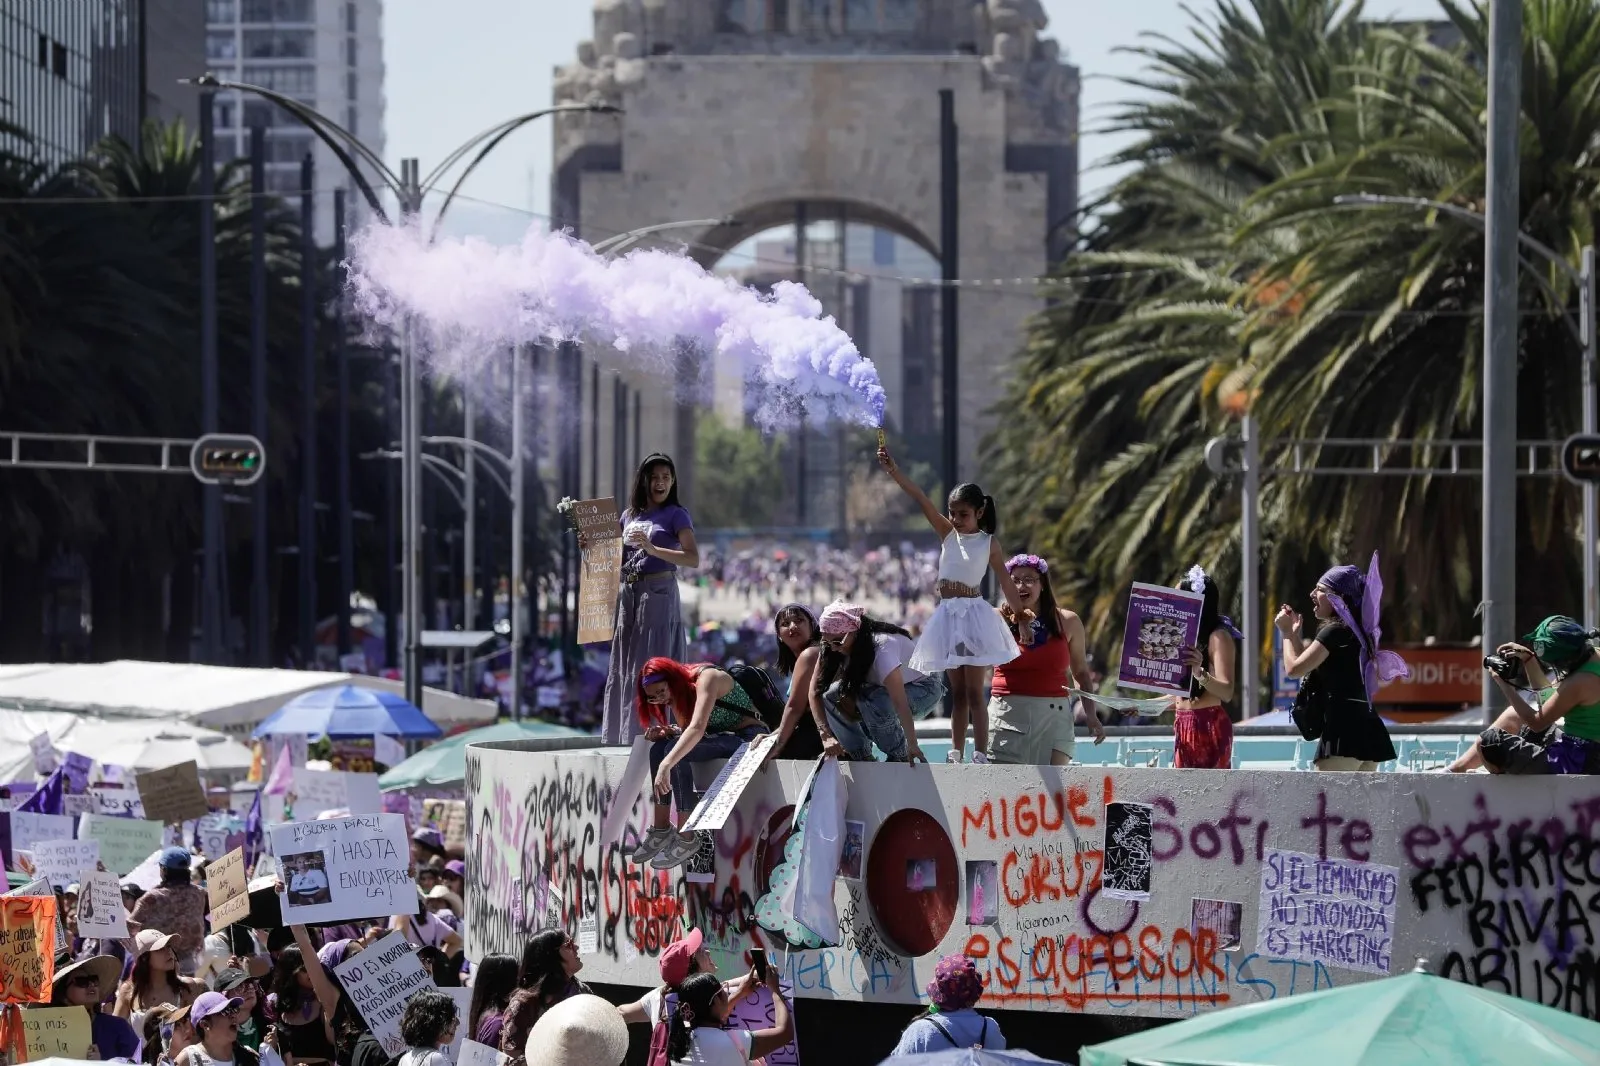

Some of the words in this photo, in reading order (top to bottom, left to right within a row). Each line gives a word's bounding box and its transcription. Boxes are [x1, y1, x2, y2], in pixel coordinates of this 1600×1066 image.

[1302, 791, 1374, 862] te
[1265, 852, 1284, 890] SI
[1289, 856, 1312, 894] EL
[1314, 860, 1396, 906] FEMINISMO
[1271, 893, 1297, 925] NO
[1303, 899, 1388, 933] INCOMODA
[1468, 889, 1600, 949] RIVA
[3, 952, 20, 971] con
[1267, 927, 1290, 955] ES
[1300, 929, 1391, 971] MARKETING
[340, 966, 363, 988] NO
[363, 959, 380, 976] ES
[352, 984, 376, 1003] QUE
[377, 968, 402, 988] NOS
[46, 1016, 68, 1030] más
[369, 1017, 379, 1030] A
[379, 1001, 406, 1024] TENER
[56, 1038, 69, 1053] la
